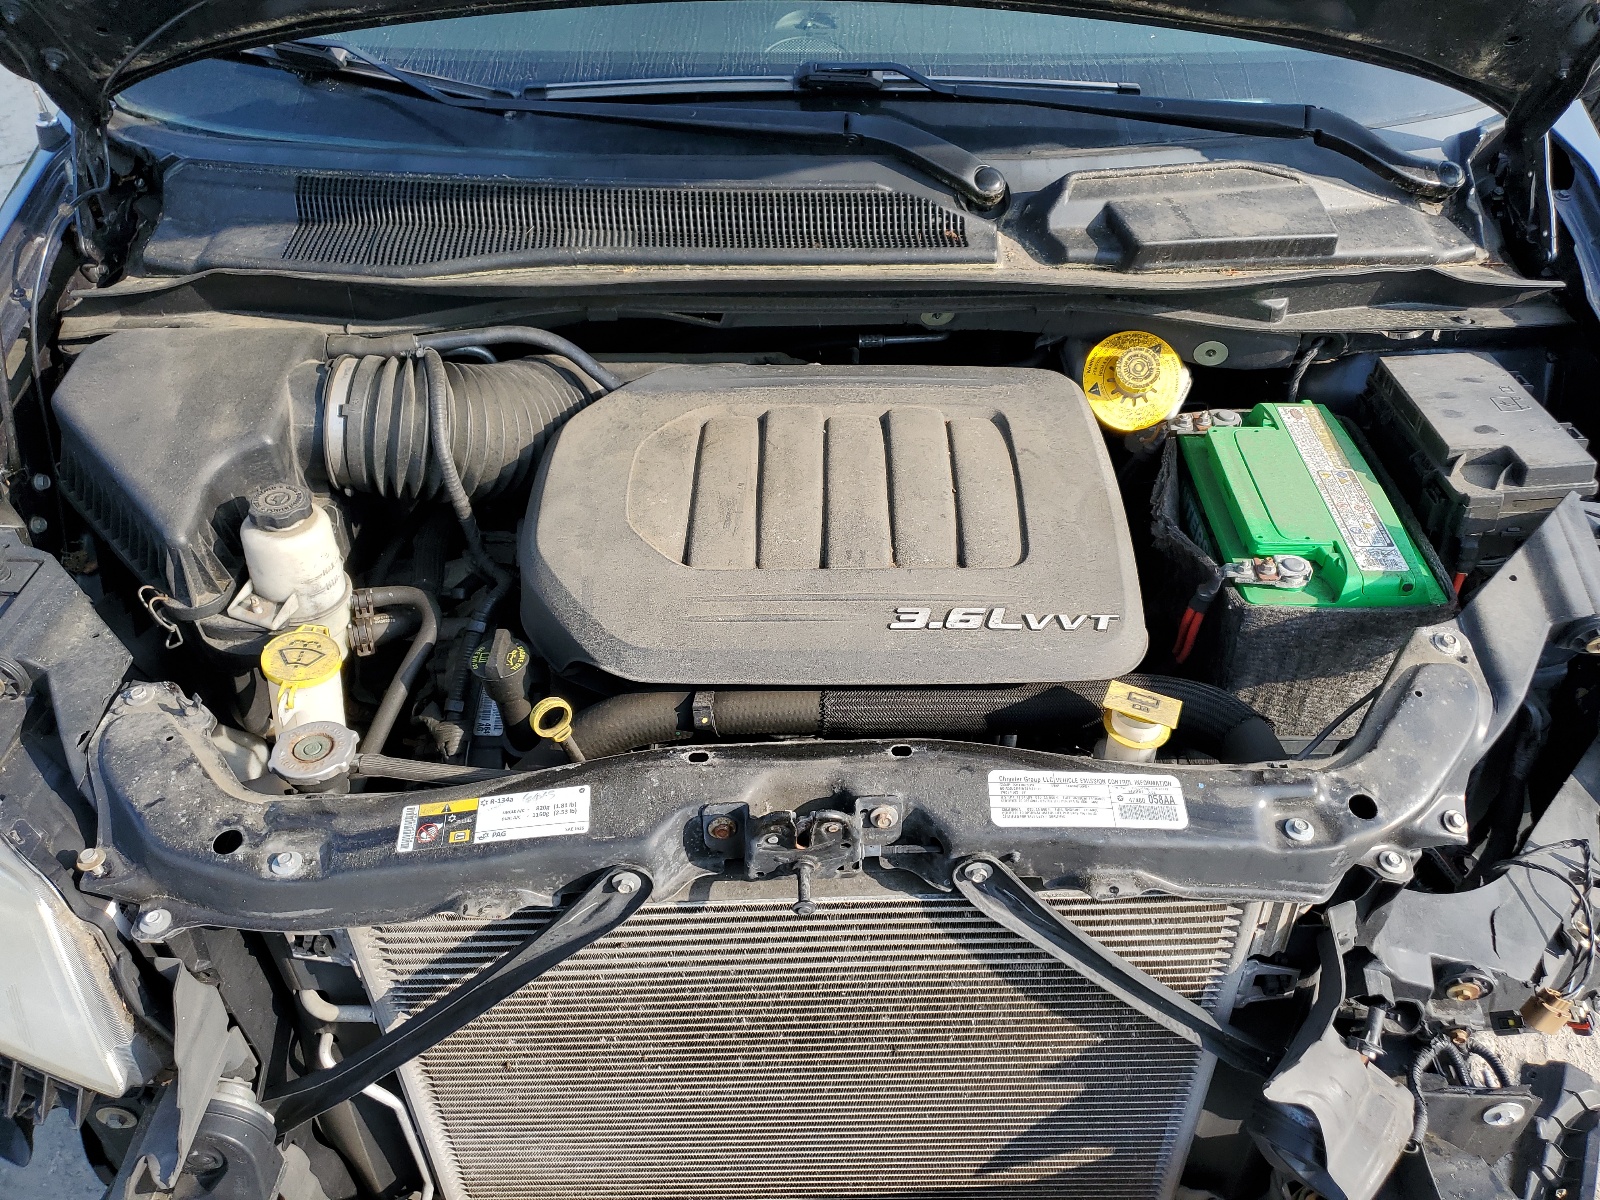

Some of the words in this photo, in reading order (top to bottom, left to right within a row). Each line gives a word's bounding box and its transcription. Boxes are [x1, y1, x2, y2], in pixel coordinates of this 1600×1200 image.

[886, 607, 1023, 631] 3.6L
[1021, 613, 1120, 632] VVT
[1024, 776, 1041, 784] Group
[489, 796, 514, 805] R-134a
[1148, 794, 1175, 805] 058AA
[491, 830, 507, 838] PAG
